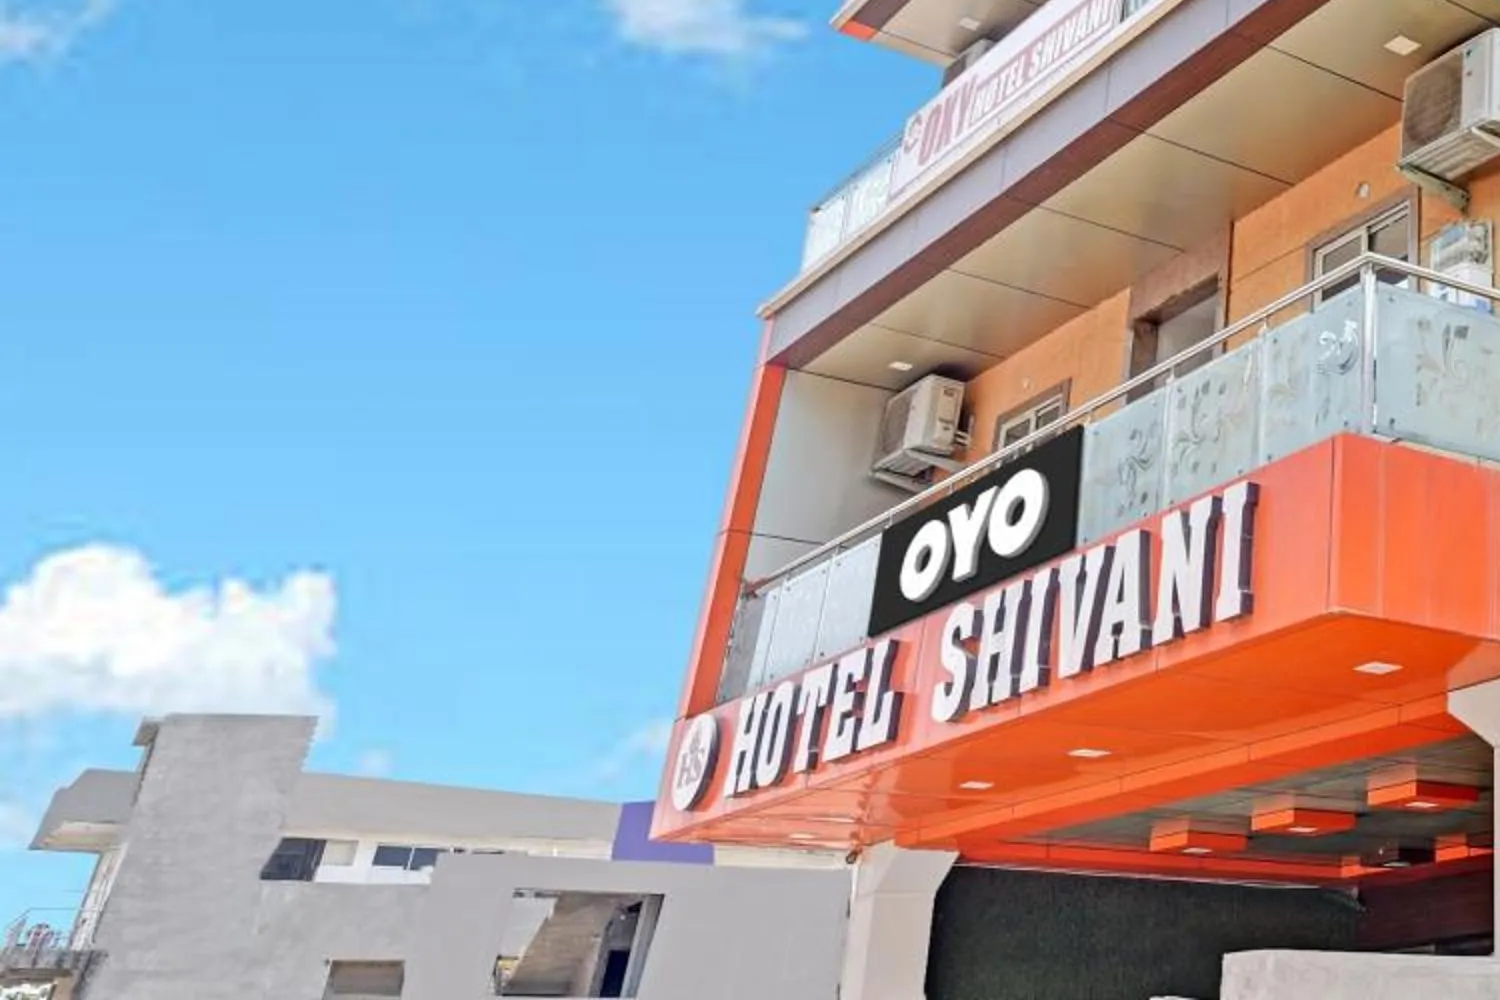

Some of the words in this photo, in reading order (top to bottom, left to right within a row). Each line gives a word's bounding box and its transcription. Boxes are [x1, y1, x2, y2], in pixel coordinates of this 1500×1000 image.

[723, 638, 904, 799] HOTEL
[930, 480, 1260, 724] SHIVANI
[899, 467, 1050, 602] OYO
